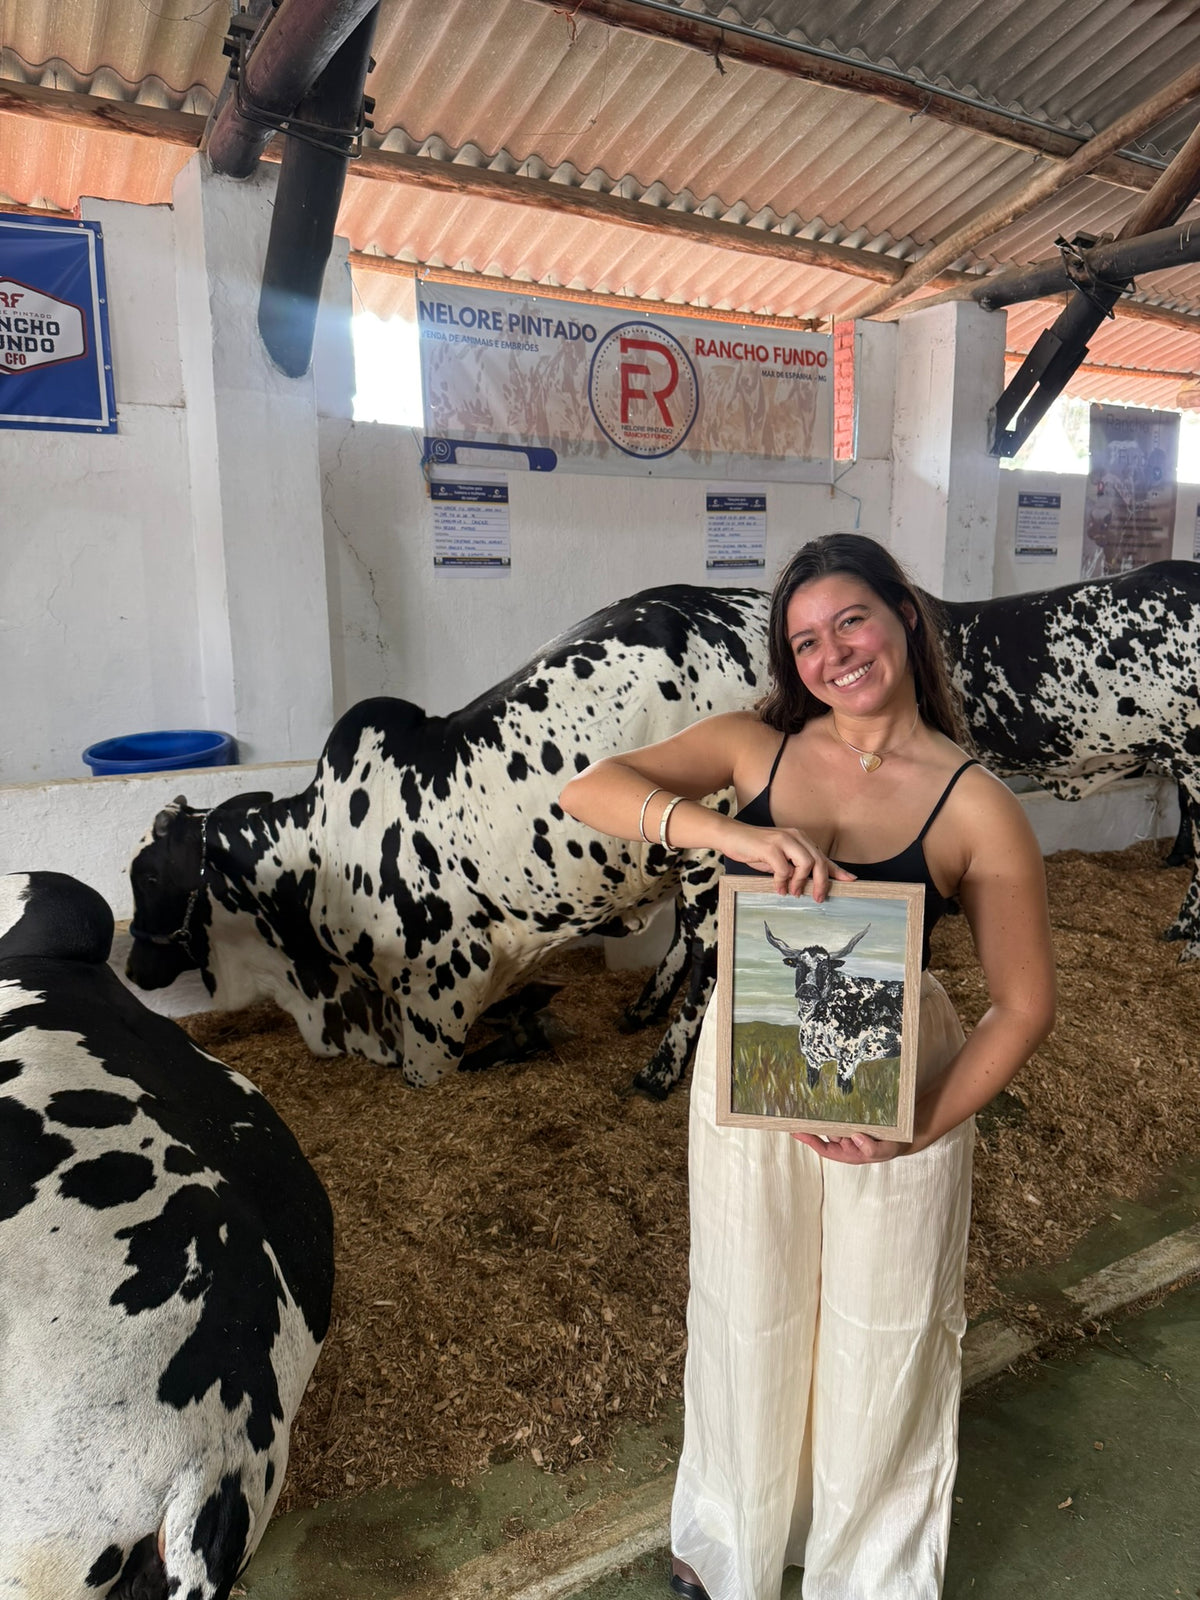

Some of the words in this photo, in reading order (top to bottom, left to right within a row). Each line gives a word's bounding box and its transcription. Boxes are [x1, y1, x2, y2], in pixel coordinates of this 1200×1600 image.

[13, 310, 52, 319] PINTADO
[419, 300, 503, 332] NELORE
[508, 313, 597, 343] PINTADO
[449, 334, 460, 343] DE
[460, 335, 494, 348] ANIMAIS
[494, 340, 499, 348] E
[501, 341, 539, 353] EMBRIÕES
[5, 352, 26, 365] CFO
[695, 337, 769, 363] RANCHO
[773, 346, 828, 368] FUNDO
[776, 370, 785, 378] DE
[785, 370, 812, 381] ESPANHA
